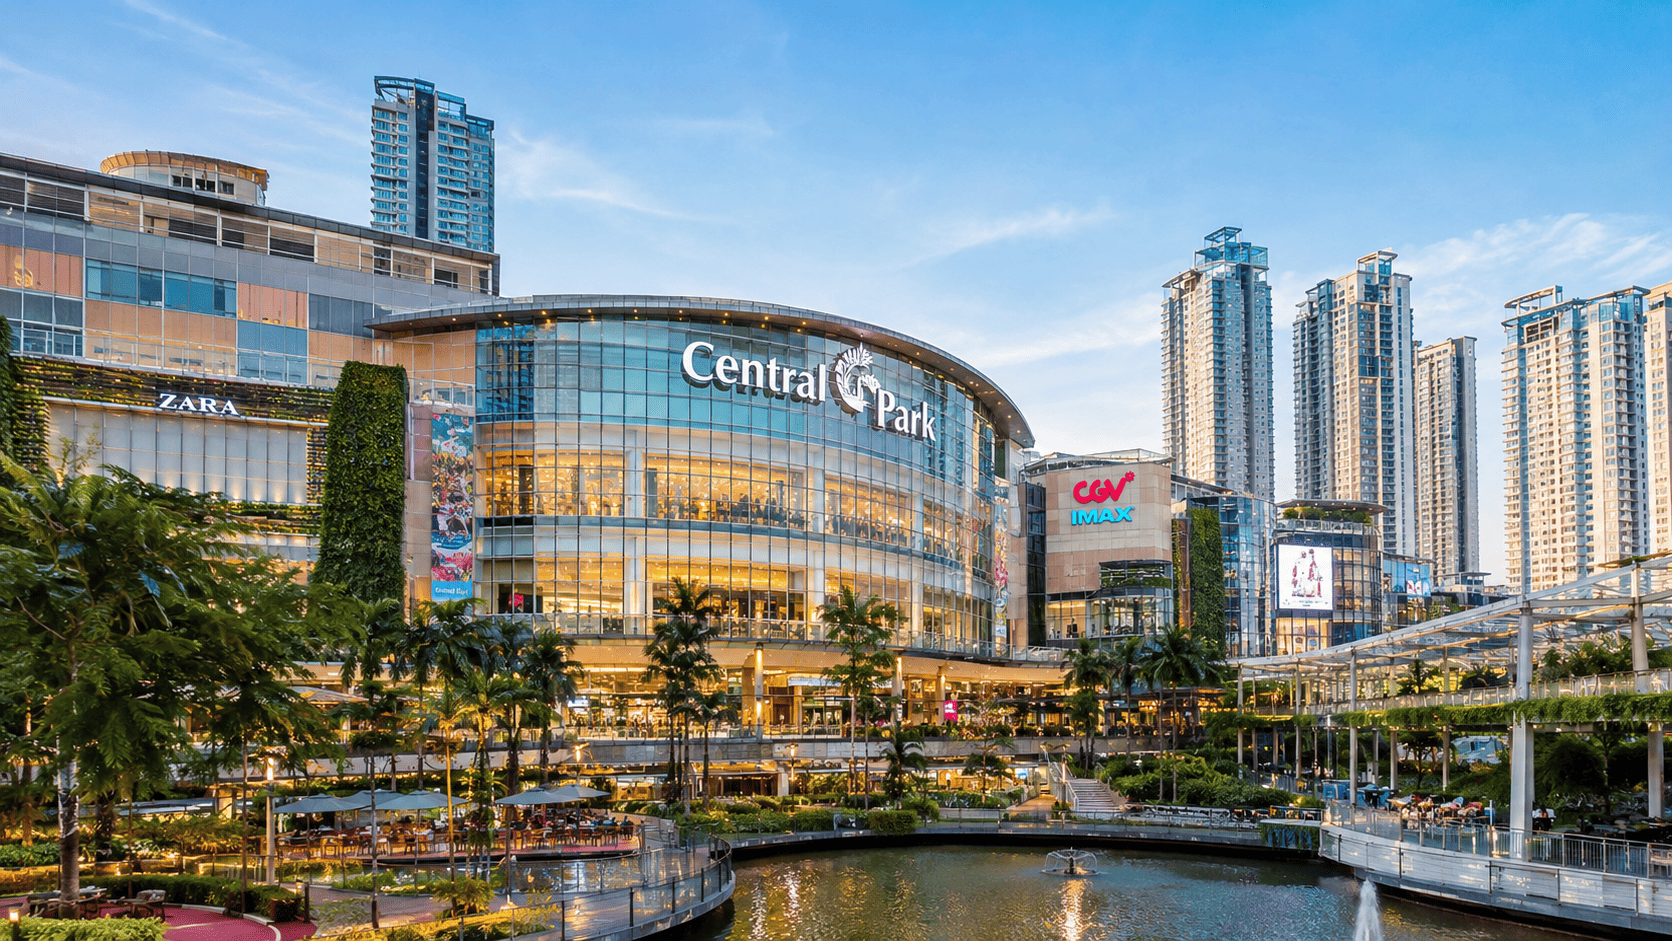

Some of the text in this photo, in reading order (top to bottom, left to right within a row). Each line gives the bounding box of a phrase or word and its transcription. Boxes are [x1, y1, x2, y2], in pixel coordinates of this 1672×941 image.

[159, 393, 241, 415] ZARA
[682, 341, 937, 441] Central Park
[1073, 472, 1134, 504] CGV
[1071, 506, 1135, 526] IMAX
